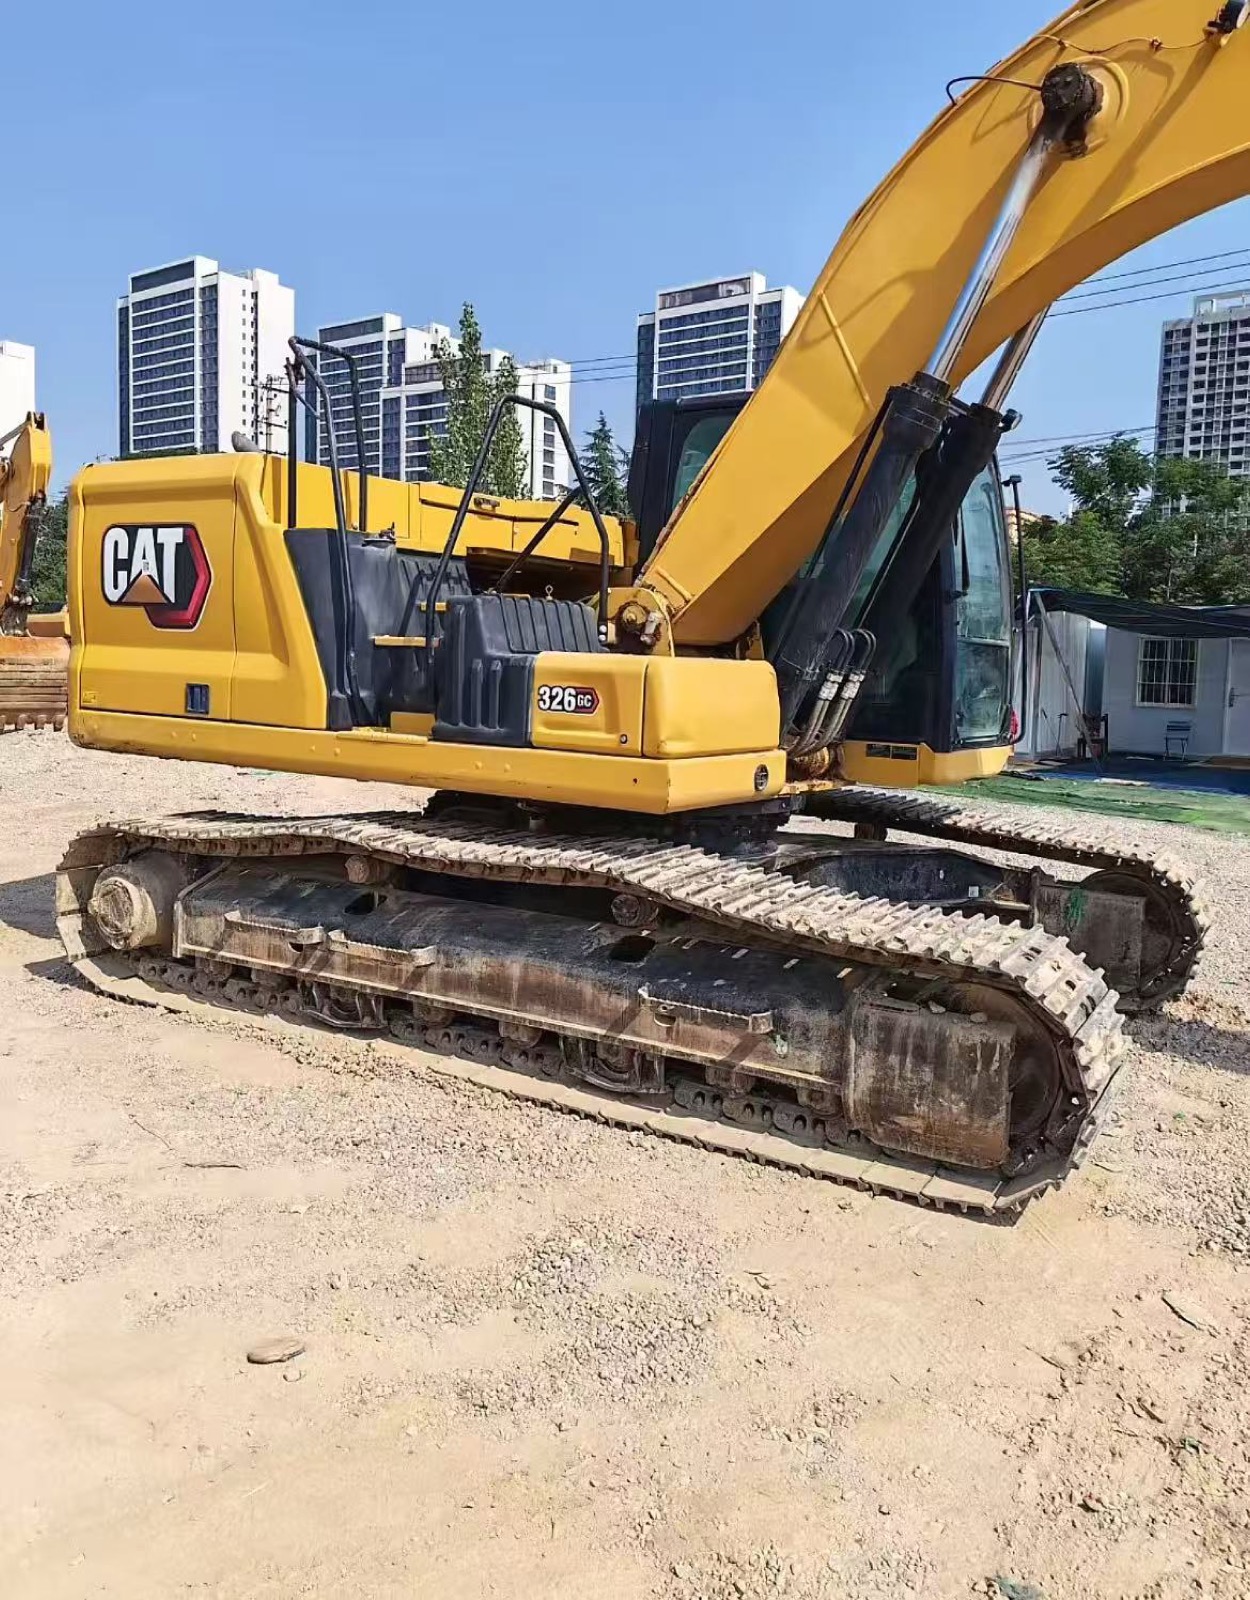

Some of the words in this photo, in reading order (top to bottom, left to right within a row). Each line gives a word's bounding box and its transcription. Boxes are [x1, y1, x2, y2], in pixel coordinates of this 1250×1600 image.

[103, 527, 184, 604] CAT
[538, 686, 576, 711] 326
[577, 694, 592, 707] GC
